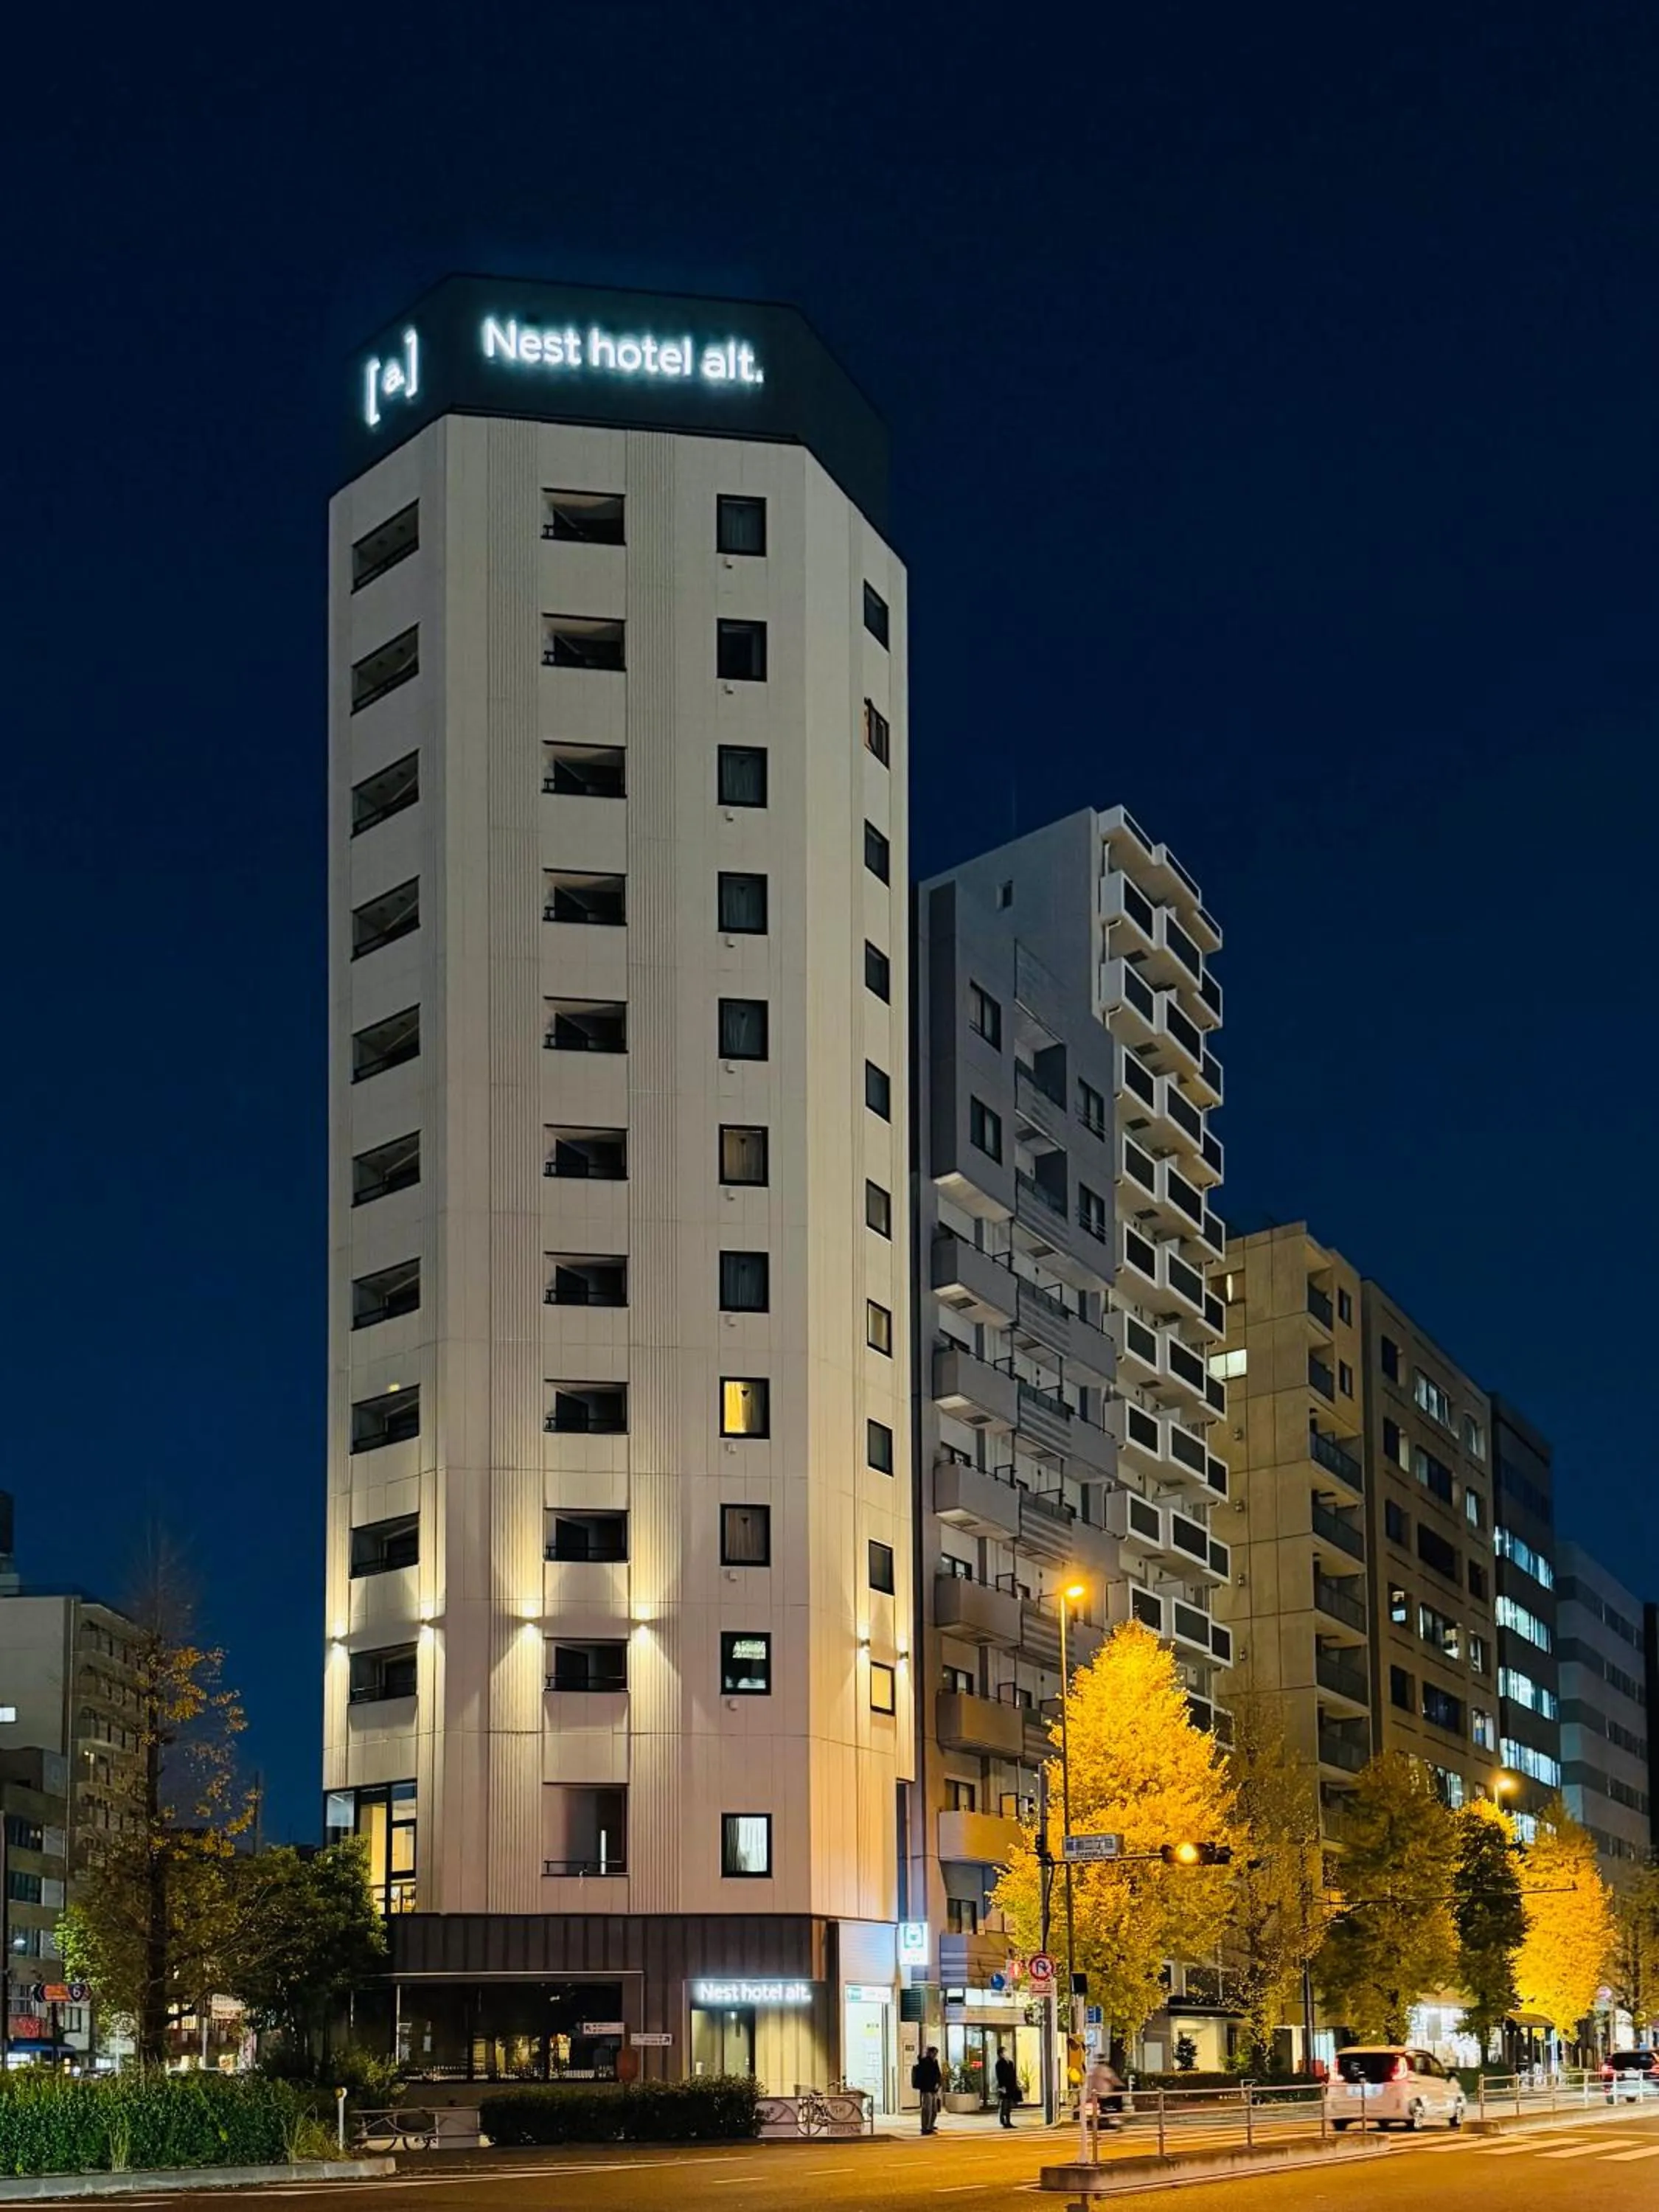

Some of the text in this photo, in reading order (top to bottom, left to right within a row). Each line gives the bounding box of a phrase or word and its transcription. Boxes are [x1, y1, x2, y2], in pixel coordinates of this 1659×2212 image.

[483, 317, 765, 383] Nest hotel alt.
[700, 1982, 813, 2003] Nest hotel alt.
